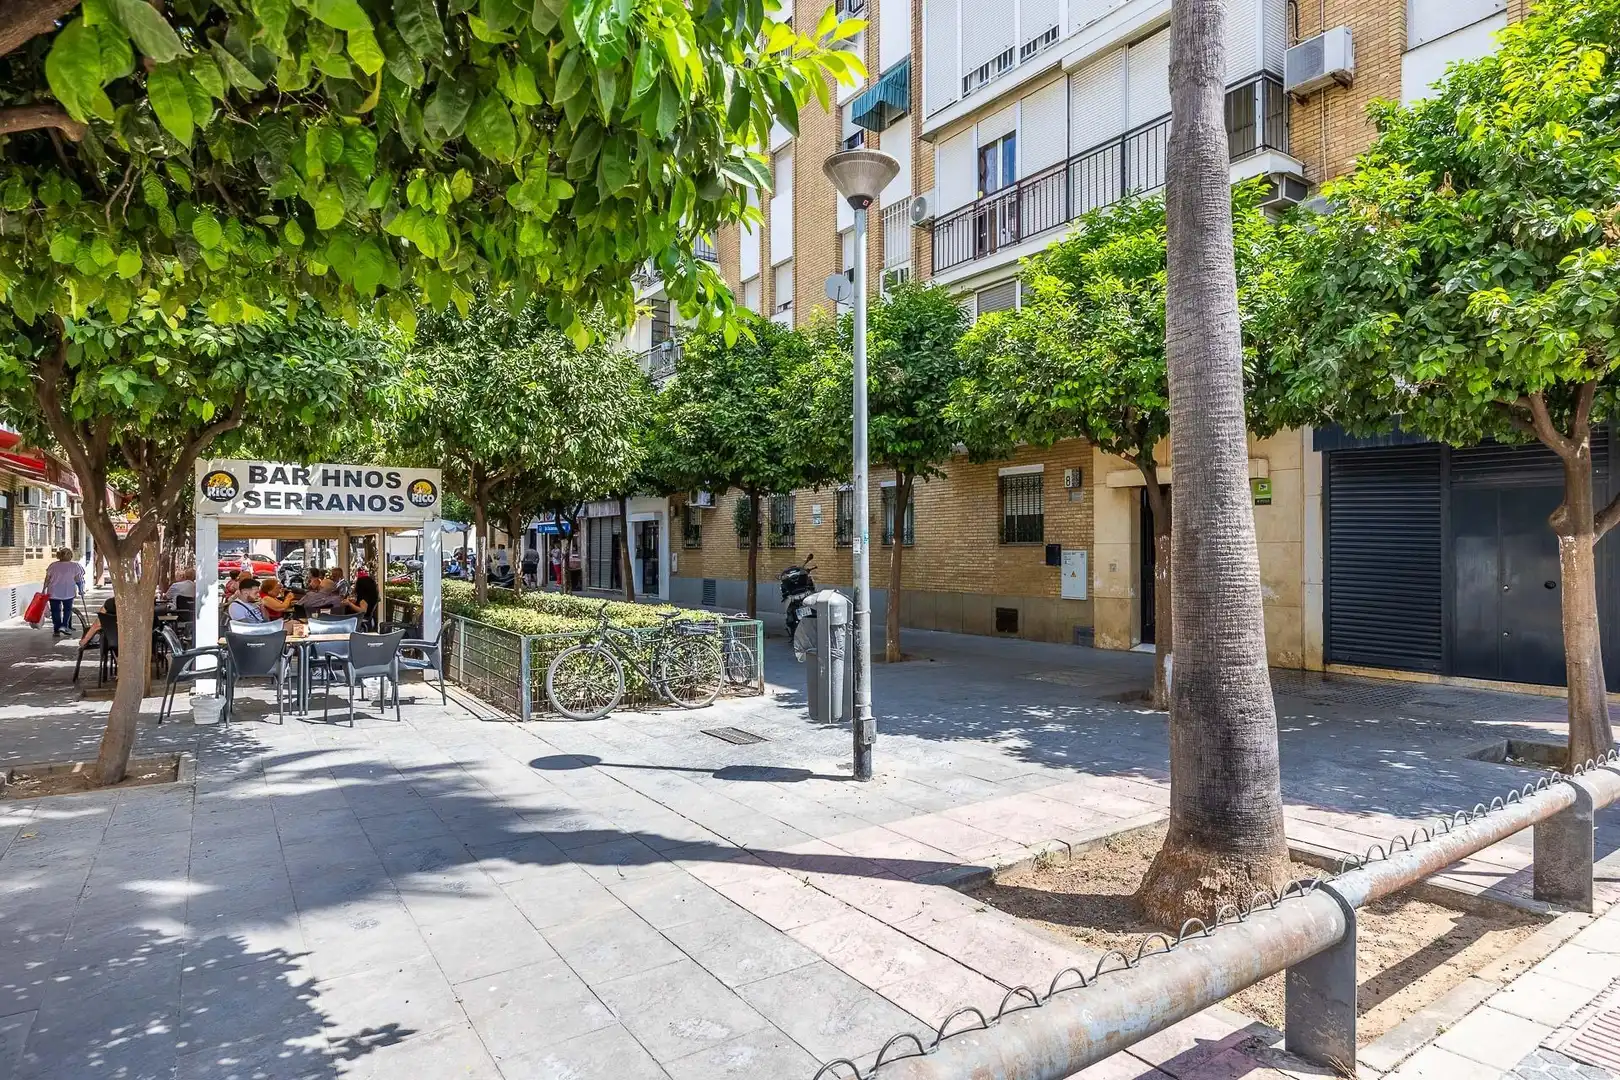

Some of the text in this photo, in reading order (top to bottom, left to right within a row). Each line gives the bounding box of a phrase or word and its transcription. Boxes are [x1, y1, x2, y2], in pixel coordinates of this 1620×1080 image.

[249, 466, 401, 489] BAR HNOS
[1066, 476, 1070, 486] 8
[243, 491, 404, 512] SERRANOS
